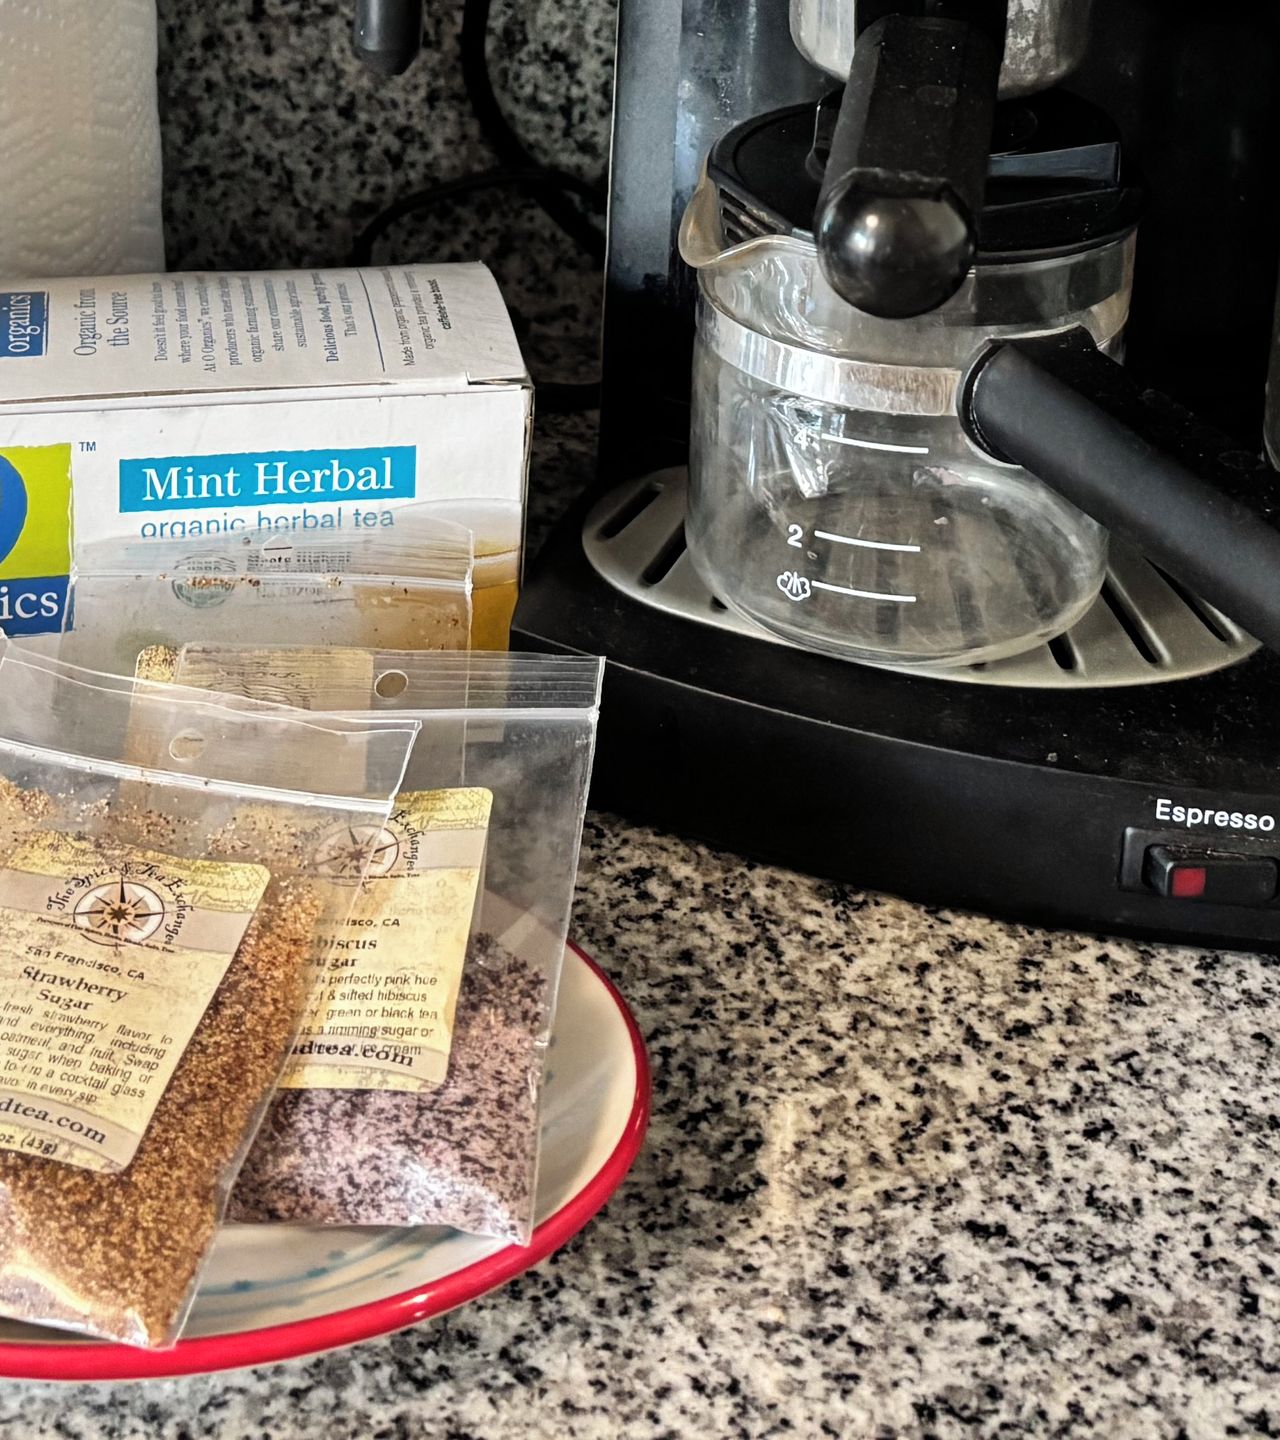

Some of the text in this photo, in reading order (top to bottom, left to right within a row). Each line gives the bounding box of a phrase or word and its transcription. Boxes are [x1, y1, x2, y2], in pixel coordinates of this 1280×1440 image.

[2, 294, 41, 353] organics
[105, 291, 129, 347] the Source
[175, 308, 187, 322] food
[221, 313, 234, 327] who
[317, 305, 332, 323] food,
[417, 315, 429, 326] tea
[431, 293, 452, 330] caffeine-free
[73, 310, 102, 356] Organic
[179, 323, 193, 339] your
[288, 309, 308, 348] sustainable
[342, 314, 358, 337] That's
[393, 308, 416, 366] Made from organic
[222, 328, 242, 366] producers
[248, 333, 265, 363] organic
[271, 331, 285, 352] share
[320, 324, 339, 362] Delicious
[420, 326, 436, 350] organic
[177, 339, 191, 363] where
[202, 362, 216, 373] At
[78, 441, 97, 452] TM
[141, 457, 395, 501] Mint Herbal
[141, 507, 395, 539] organic herbal tea
[787, 524, 803, 548] 2
[1155, 798, 1276, 832] Espresso
[46, 886, 75, 911] The
[73, 865, 120, 889] Spice
[136, 862, 166, 883] Tea
[382, 918, 401, 927] CA
[317, 934, 378, 951] biscus
[25, 946, 146, 981] San Francisco, CA
[313, 958, 358, 971] ugar
[23, 966, 128, 1003] Strawberry
[328, 972, 382, 989] perfectly
[384, 972, 411, 988] pink
[414, 974, 438, 985] hue
[36, 989, 94, 1011] Sugar
[327, 990, 336, 1001] &
[339, 989, 374, 1001] sifted
[377, 990, 428, 1002] hibiscus
[326, 1008, 362, 1020] green
[365, 1009, 378, 1018] or
[380, 1007, 415, 1020] black
[419, 1009, 438, 1020] tea
[42, 1009, 108, 1032] strawberry
[116, 1024, 153, 1041] flavor
[160, 1034, 173, 1045] to
[380, 1026, 417, 1040] sugar
[58, 1041, 86, 1055] and
[123, 1054, 160, 1072] Swap
[110, 1038, 167, 1060] including
[6, 1046, 43, 1061] sugar
[48, 1053, 82, 1068] when
[89, 1061, 133, 1083] baking
[138, 1073, 154, 1085] or
[4, 1060, 17, 1071] to
[45, 1068, 55, 1079] a
[60, 1071, 109, 1091] cocktail
[110, 1082, 146, 1099] glass
[26, 1081, 38, 1090] in
[20, 1131, 59, 1155] (43g)
